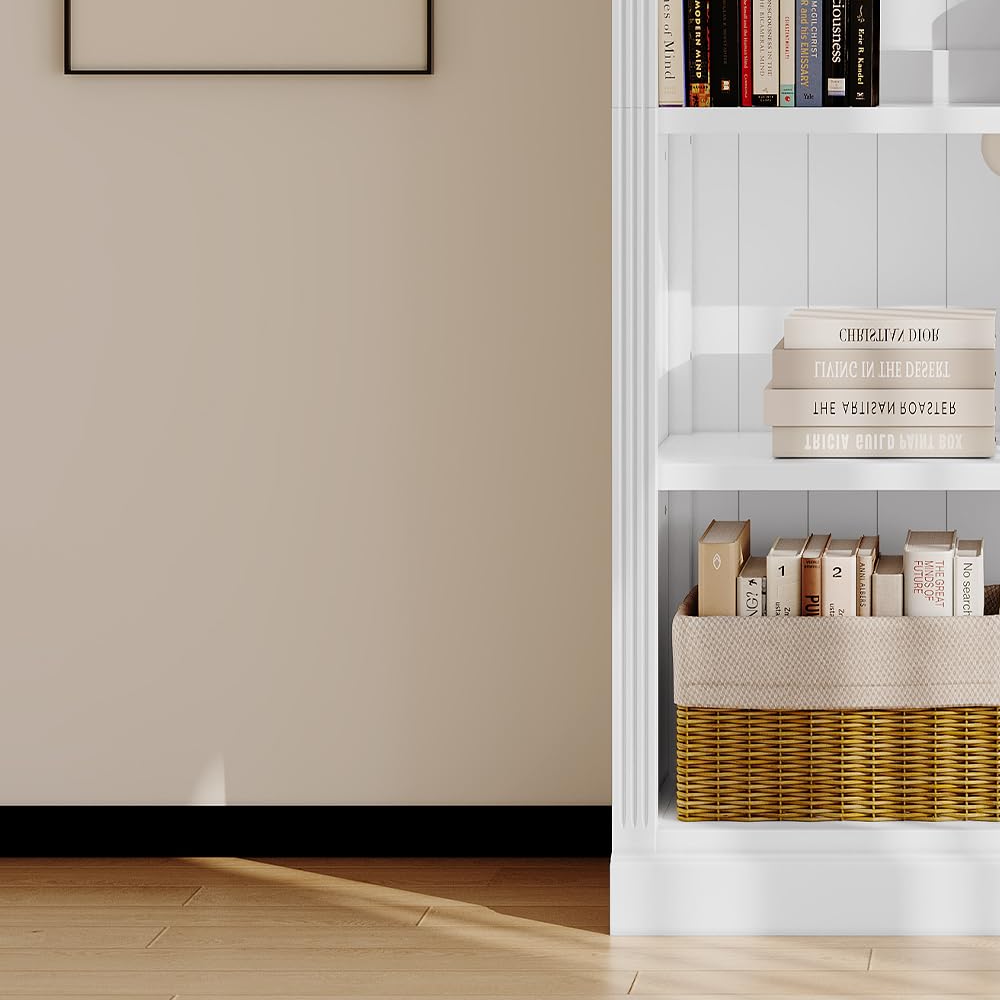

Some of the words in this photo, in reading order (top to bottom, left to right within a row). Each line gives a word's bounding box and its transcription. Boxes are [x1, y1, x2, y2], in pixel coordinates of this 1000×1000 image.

[694, 0, 702, 46] MODERN
[801, 8, 810, 24] and
[663, 24, 674, 37] of
[801, 26, 810, 40] his
[664, 40, 676, 80] Mind
[801, 42, 810, 87] EMISSARY
[778, 565, 786, 577] 1
[832, 567, 842, 578] 2
[914, 560, 924, 594] FUTURE
[924, 560, 934, 588] MINDS
[935, 560, 944, 577] THE
[963, 562, 973, 578] No
[924, 590, 934, 601] OF
[935, 579, 944, 608] GREAT
[963, 580, 973, 617] search
